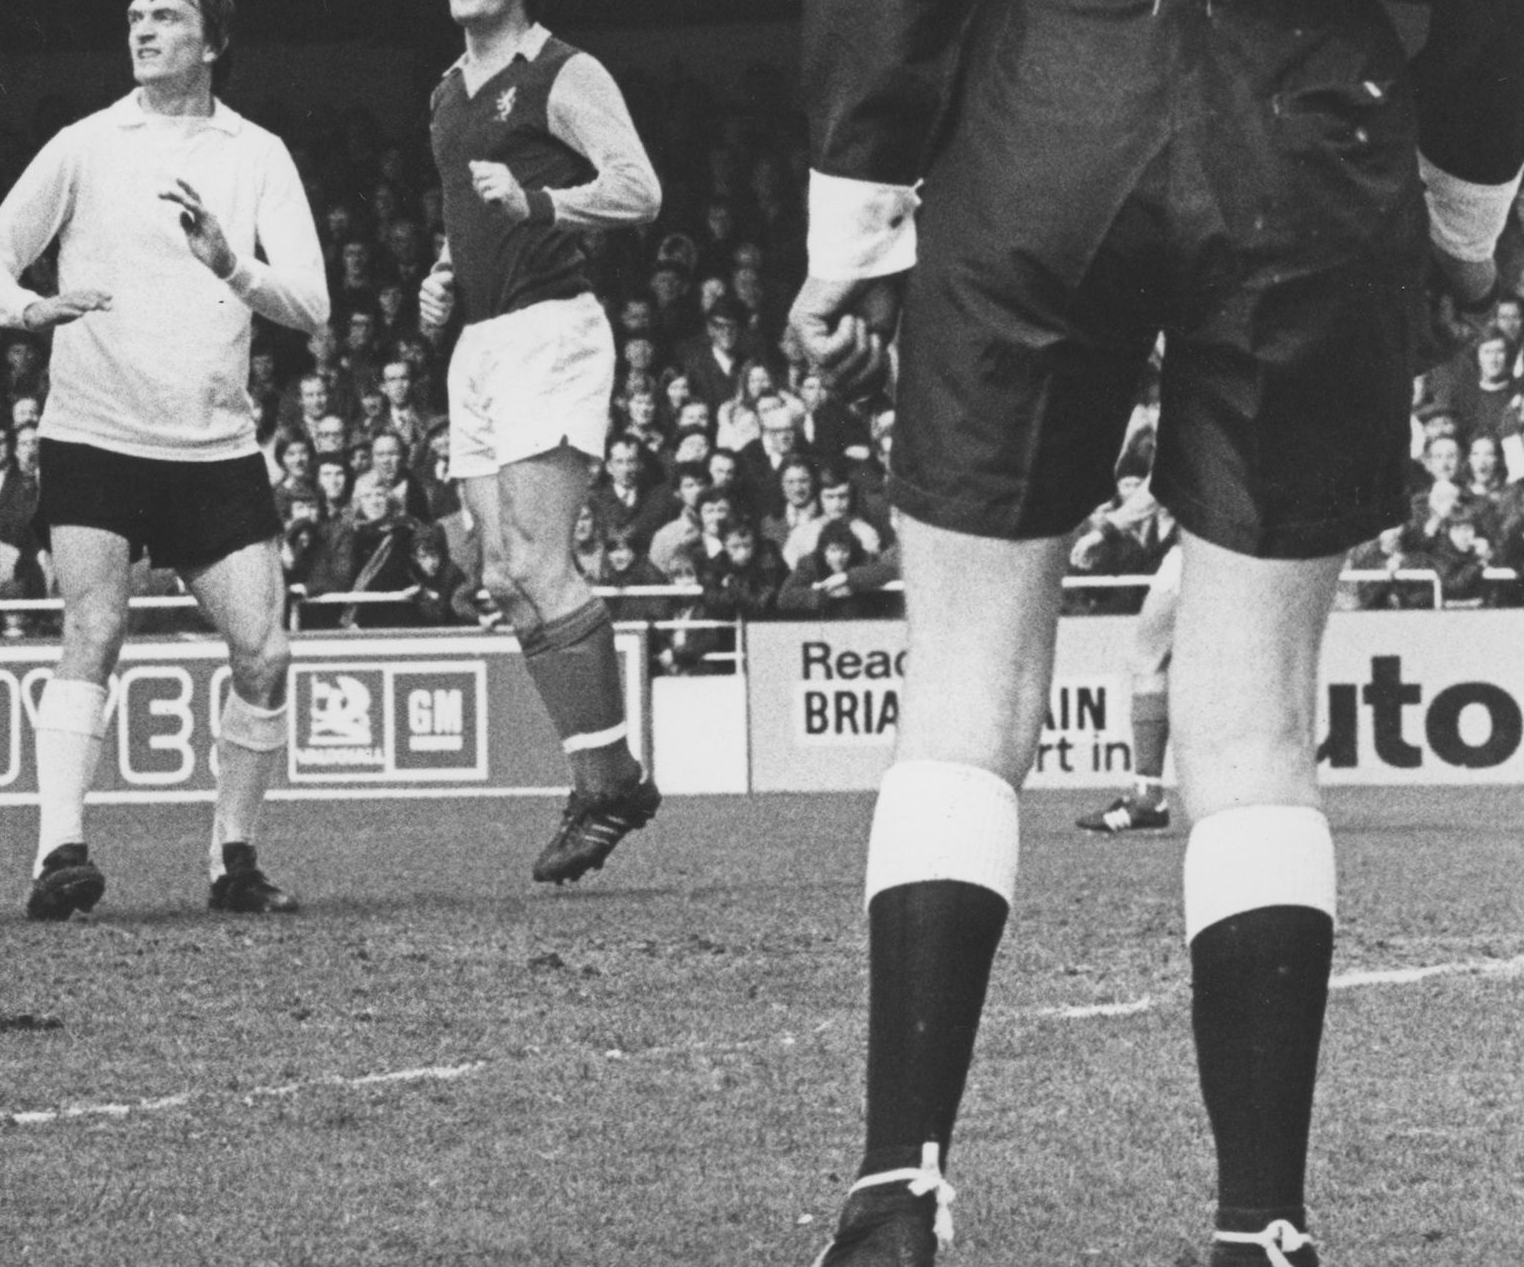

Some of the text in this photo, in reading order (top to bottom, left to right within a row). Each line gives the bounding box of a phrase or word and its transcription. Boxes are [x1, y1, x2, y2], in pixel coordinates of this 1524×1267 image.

[408, 688, 463, 734] GM
[1040, 686, 1106, 730] IN
[1092, 734, 1132, 771] in
